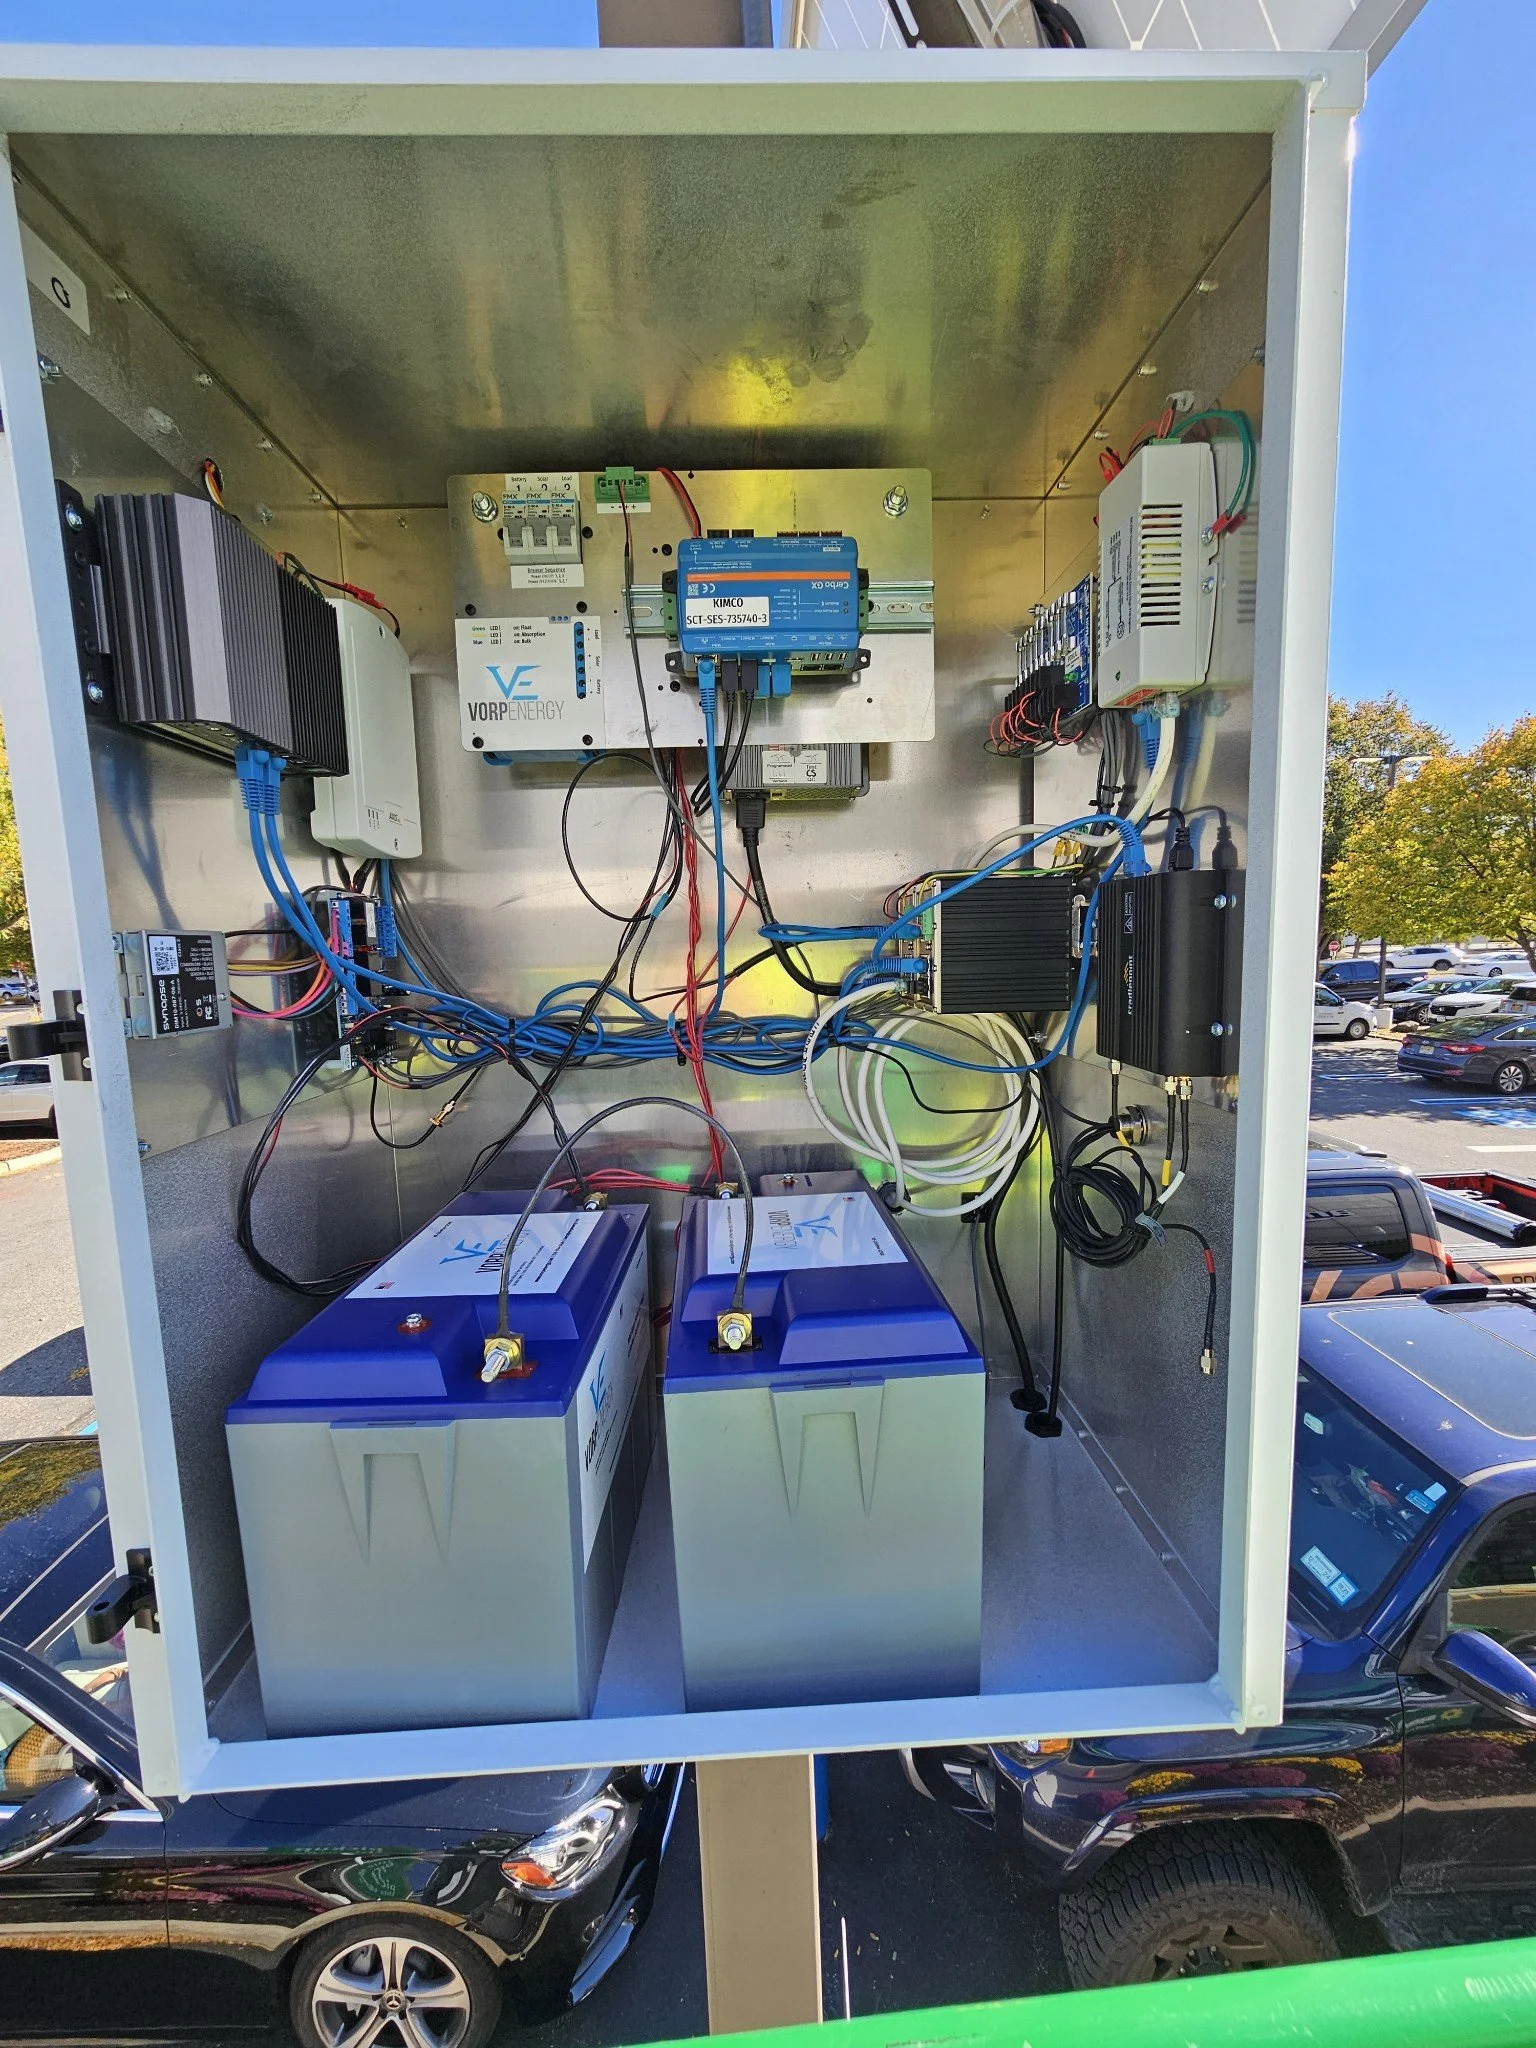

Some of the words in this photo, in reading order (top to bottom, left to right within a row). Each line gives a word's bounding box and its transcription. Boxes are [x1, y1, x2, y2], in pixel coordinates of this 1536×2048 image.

[713, 597, 744, 608] KIMCO
[686, 613, 767, 625] SCT-SES-735740-3
[467, 700, 565, 722] VORPENERGY
[158, 979, 170, 1031] synapse
[1512, 1275, 1536, 1284] on
